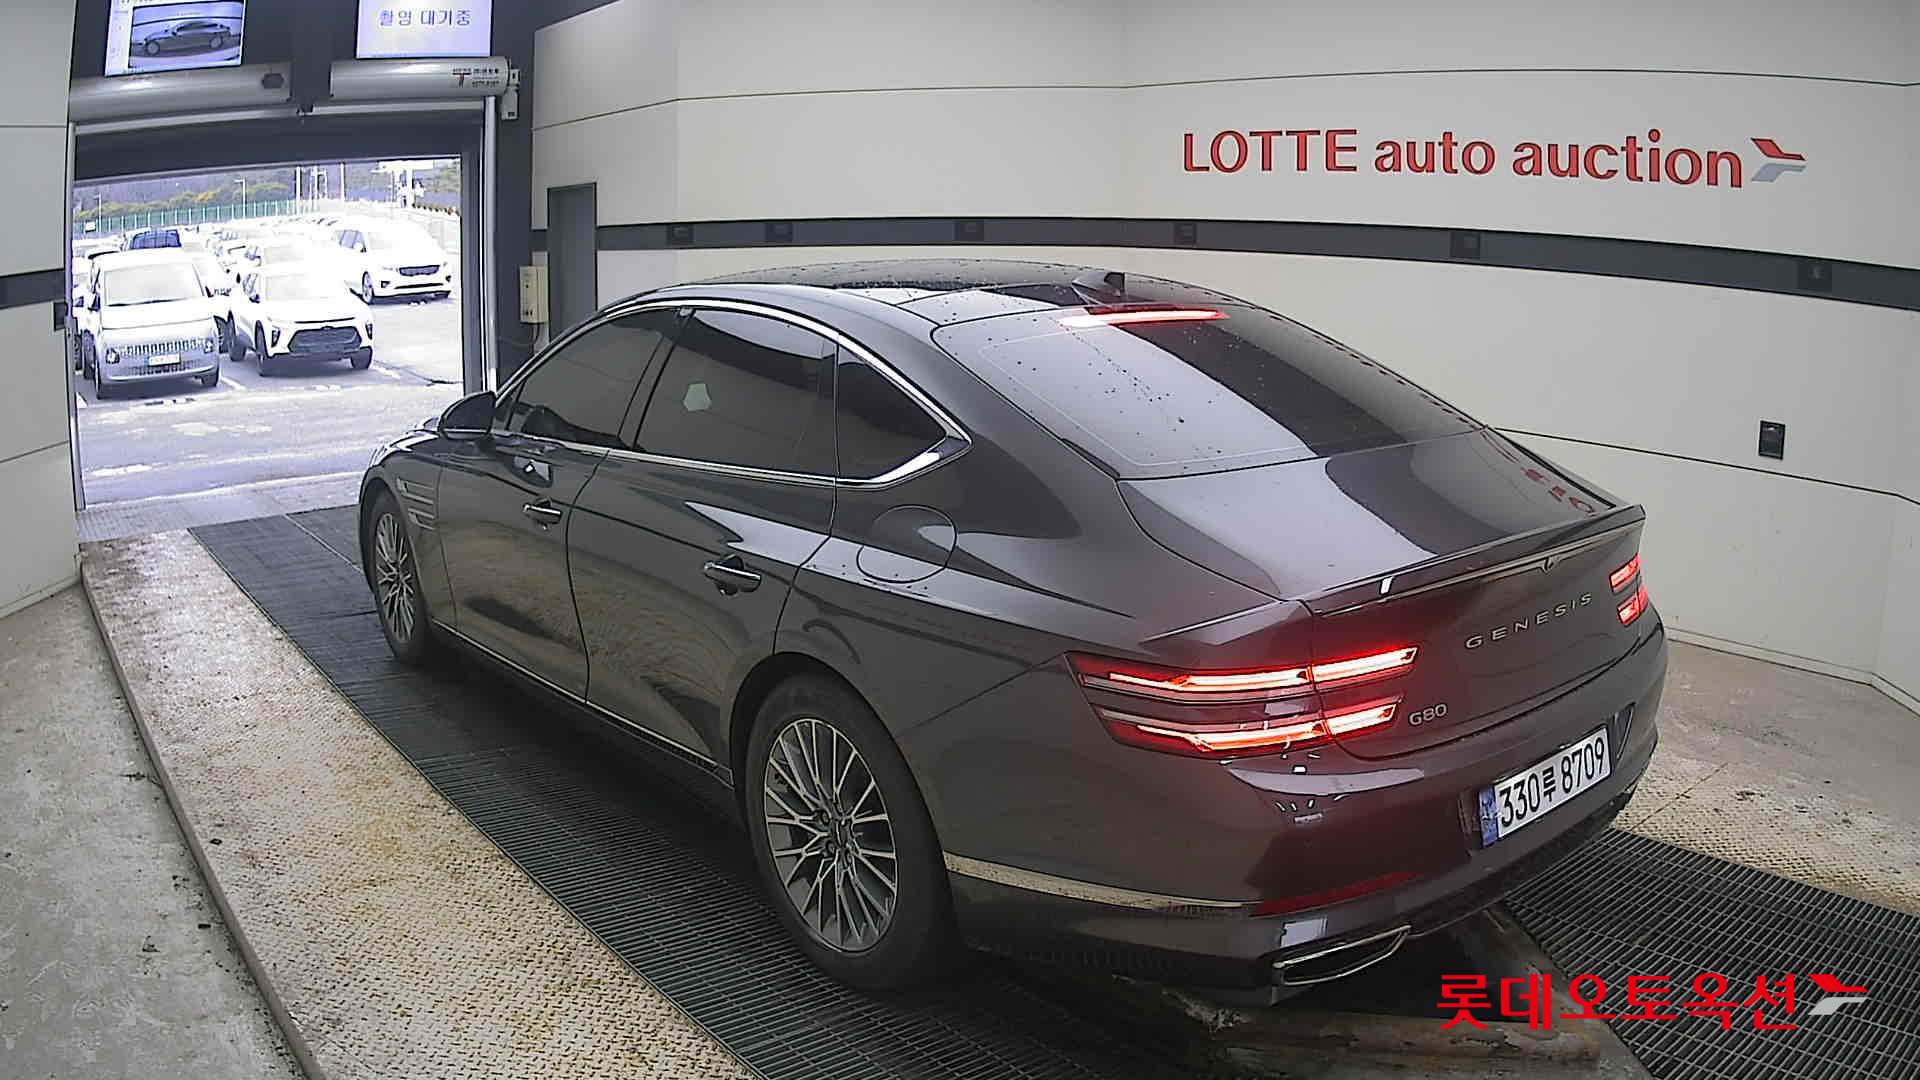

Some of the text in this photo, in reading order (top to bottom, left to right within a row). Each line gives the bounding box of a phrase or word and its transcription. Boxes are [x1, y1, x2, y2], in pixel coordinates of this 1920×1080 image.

[1183, 128, 1743, 188] LOTTE auto auction
[1465, 592, 1592, 649] GENESIS
[1408, 703, 1448, 726] G80
[1499, 737, 1604, 828] 330루 8709
